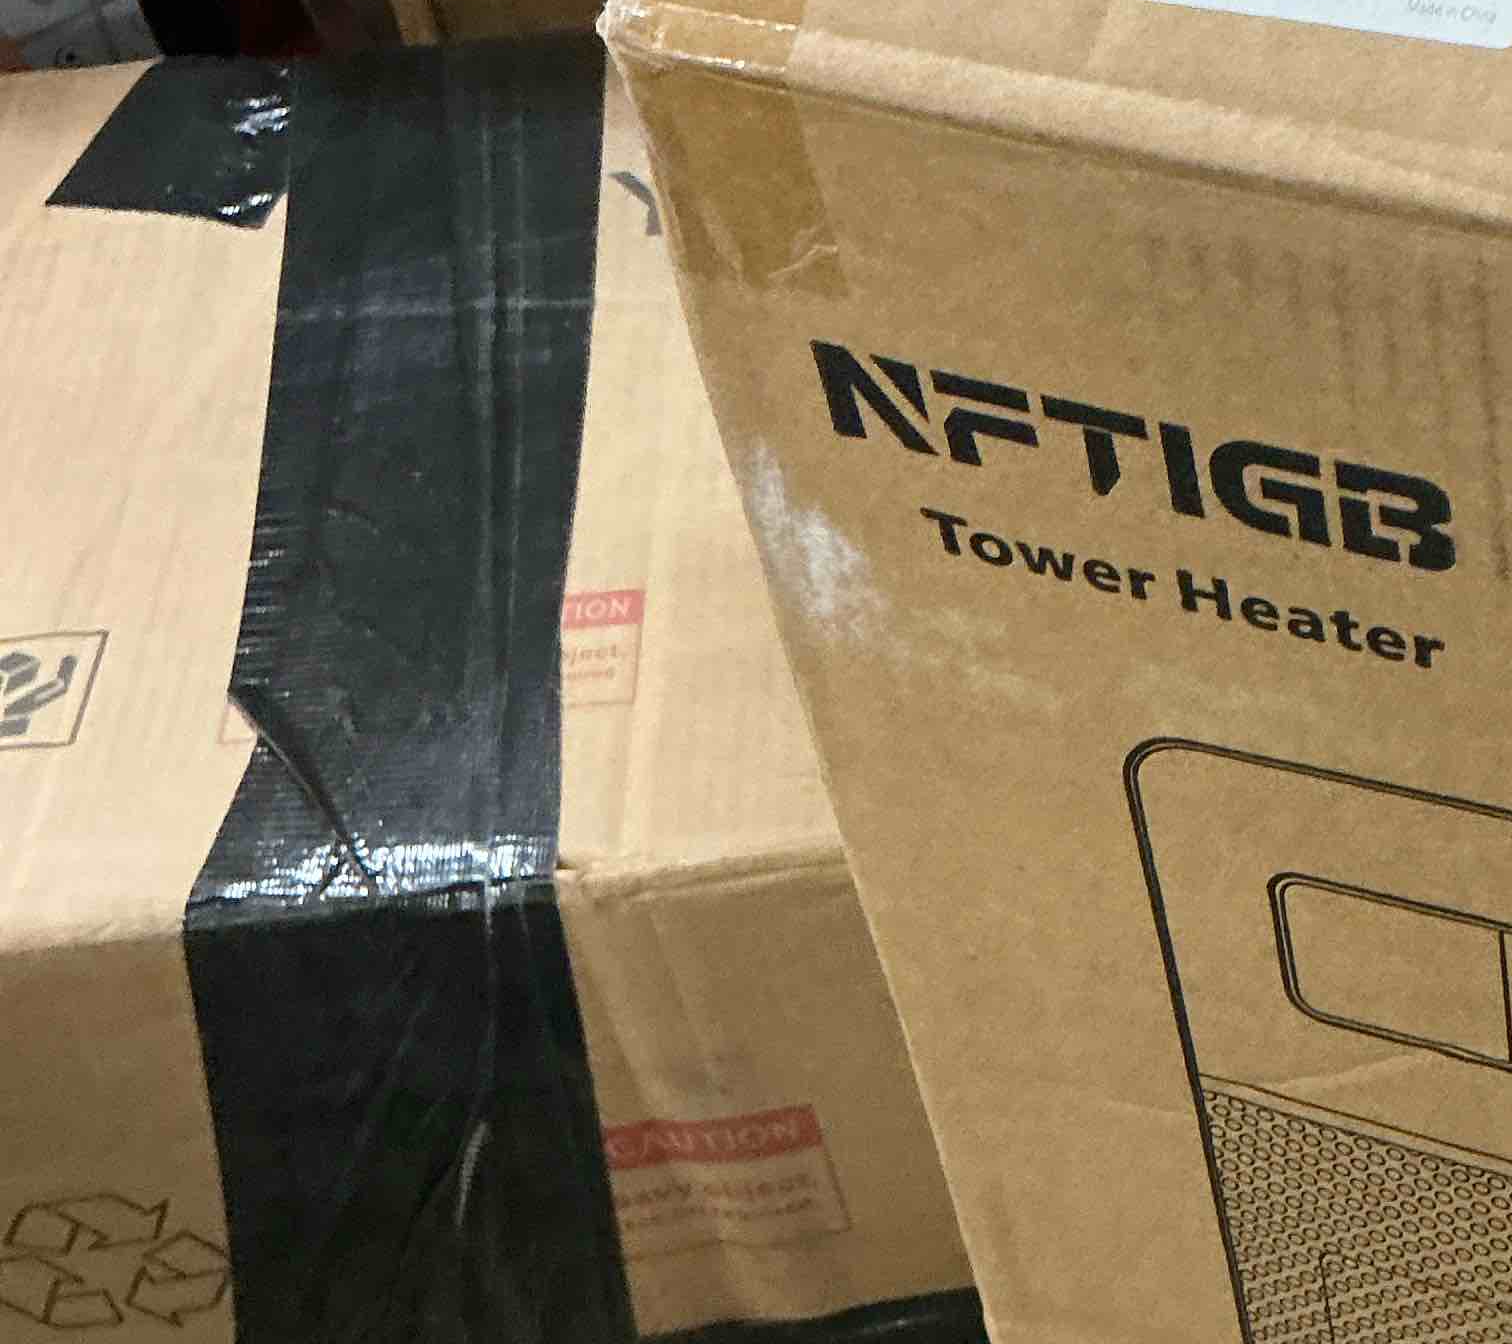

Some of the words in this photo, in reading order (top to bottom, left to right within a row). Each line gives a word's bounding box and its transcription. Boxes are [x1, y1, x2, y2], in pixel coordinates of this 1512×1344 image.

[809, 340, 1456, 572] NFTIGB
[921, 507, 1156, 602] Tower
[1177, 568, 1445, 669] Heater
